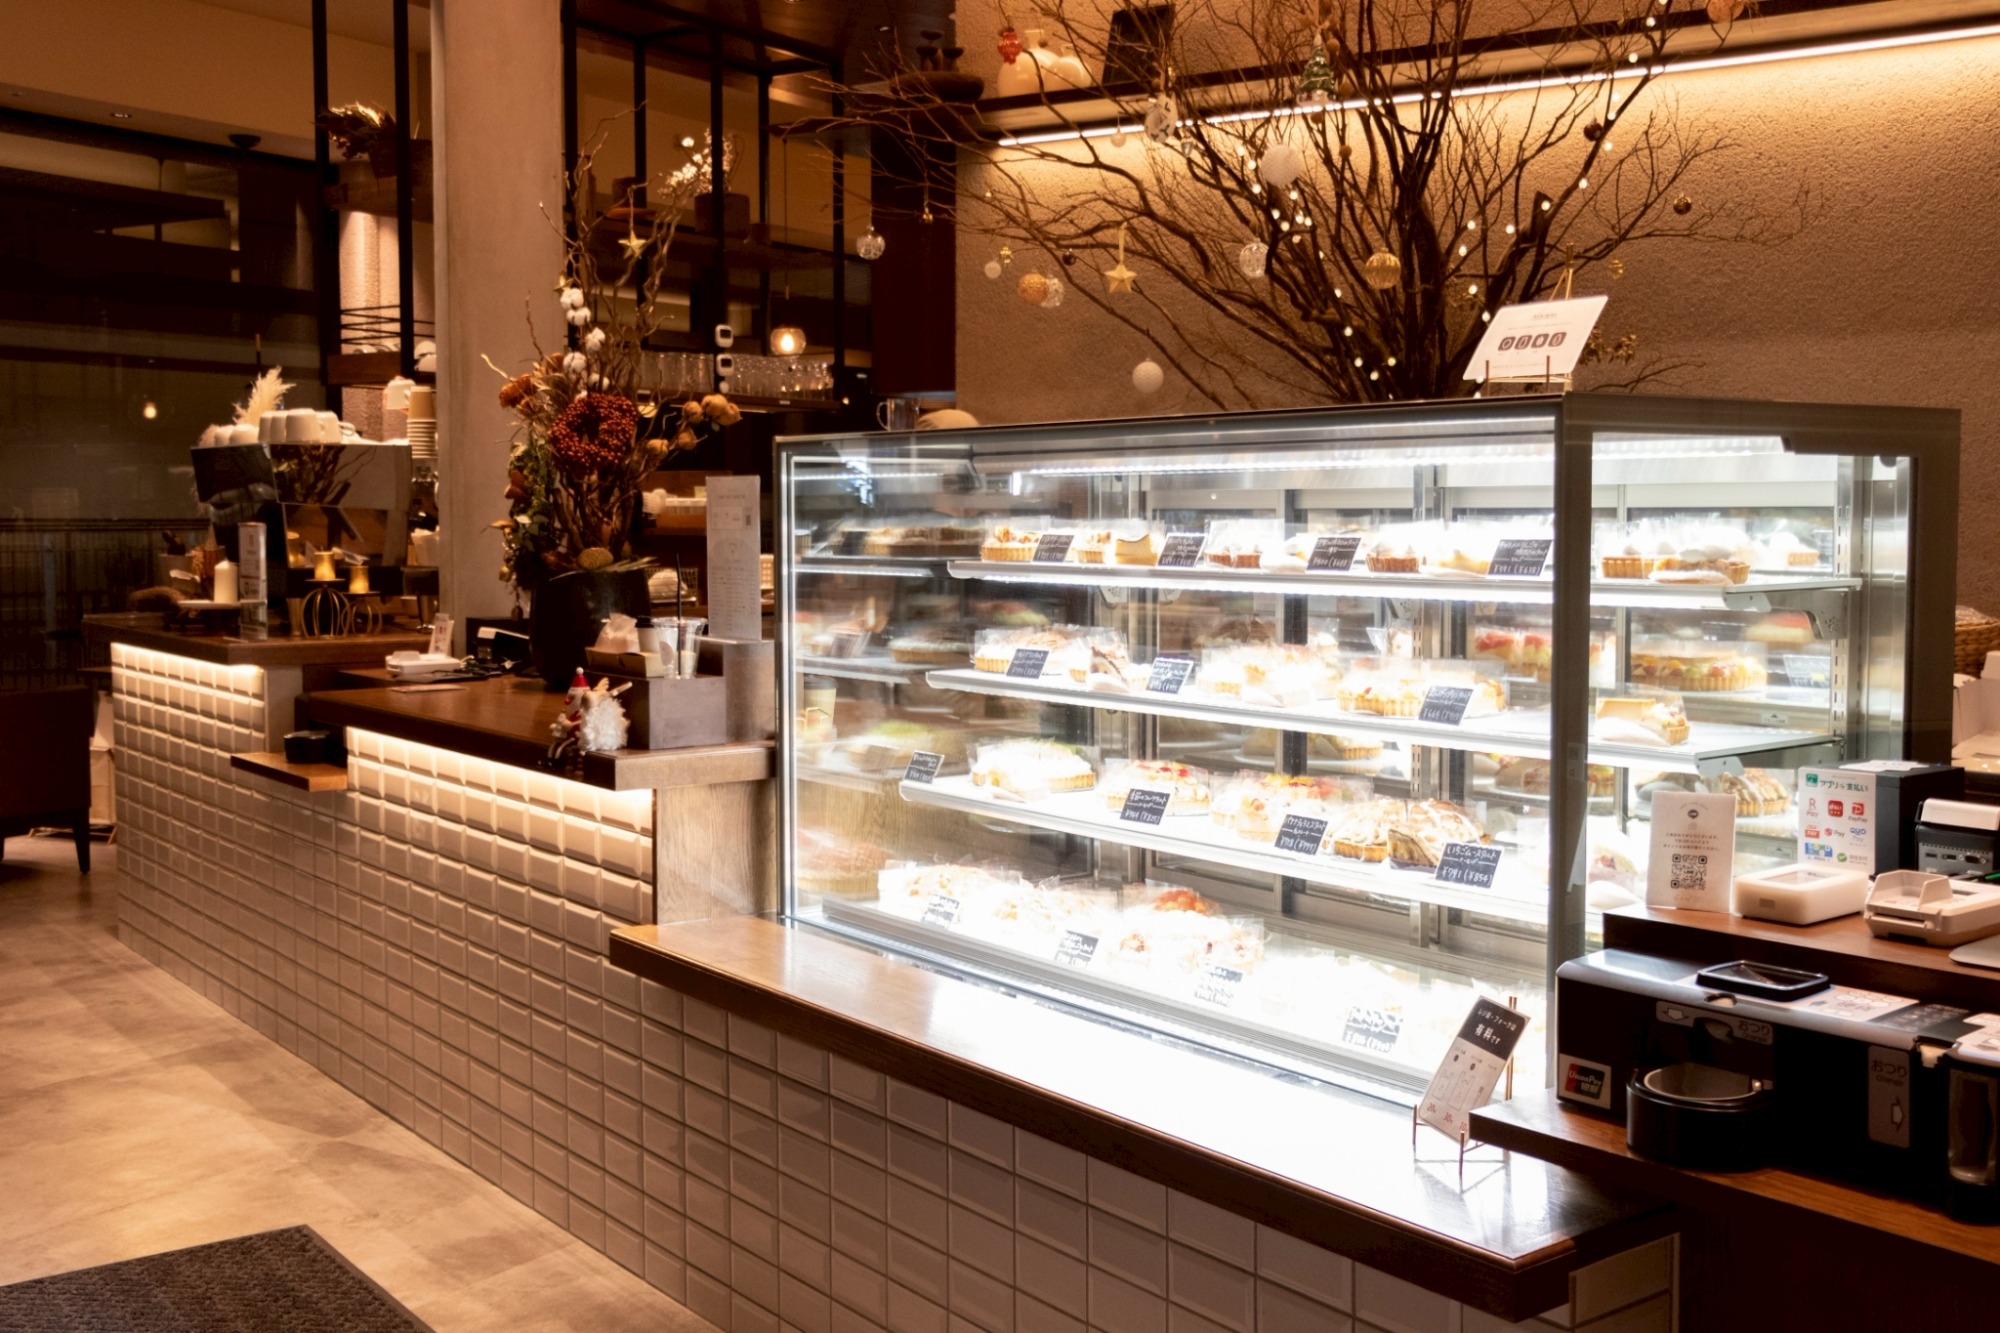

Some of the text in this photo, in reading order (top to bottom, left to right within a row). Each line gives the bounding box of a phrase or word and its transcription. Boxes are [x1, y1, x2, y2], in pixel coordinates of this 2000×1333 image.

[1475, 1023, 1501, 1045] 有料です
[1737, 1020, 1770, 1036] おつり
[1871, 1060, 1907, 1078] おつり
[1569, 1070, 1602, 1087] UnionPay
